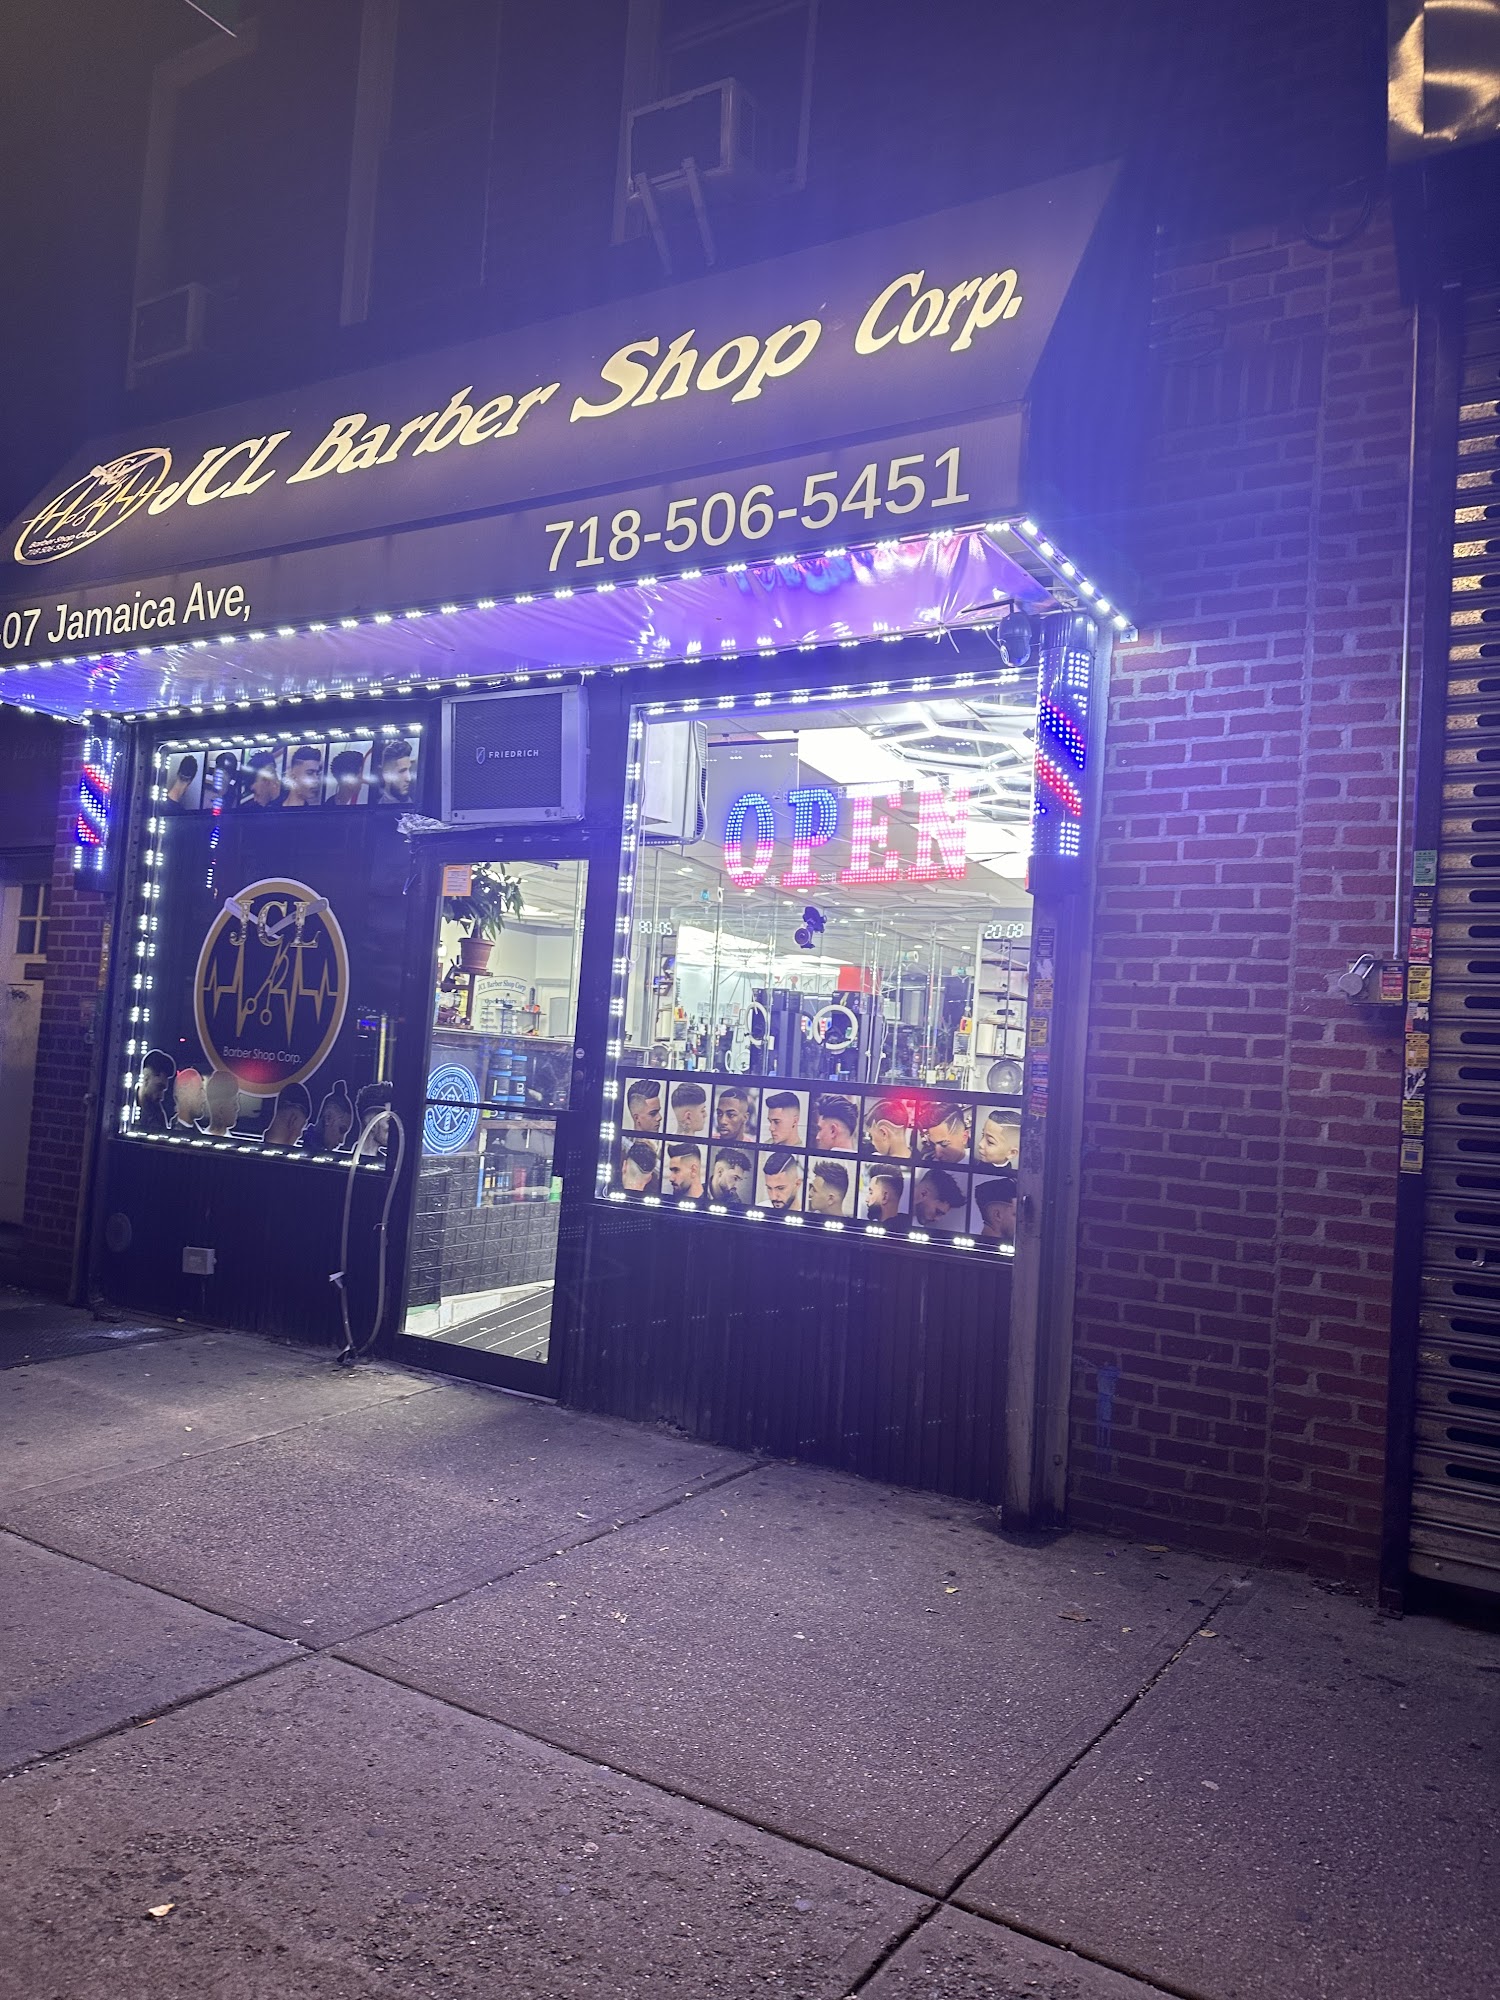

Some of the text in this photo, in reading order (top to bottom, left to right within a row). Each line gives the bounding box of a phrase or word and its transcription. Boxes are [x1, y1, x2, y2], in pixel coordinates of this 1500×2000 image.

[148, 268, 1023, 515] JCL Barber Shop Corp.
[544, 446, 970, 572] 718-506-5451
[0, 582, 252, 649] 07 Jamaica Ave,
[488, 749, 539, 759] FRIEDRICH
[724, 780, 971, 887] OPEN
[229, 900, 321, 948] JCL
[487, 979, 503, 989] Barber
[503, 979, 515, 989] Shop
[223, 1046, 302, 1065] Barber Shop Corp.
